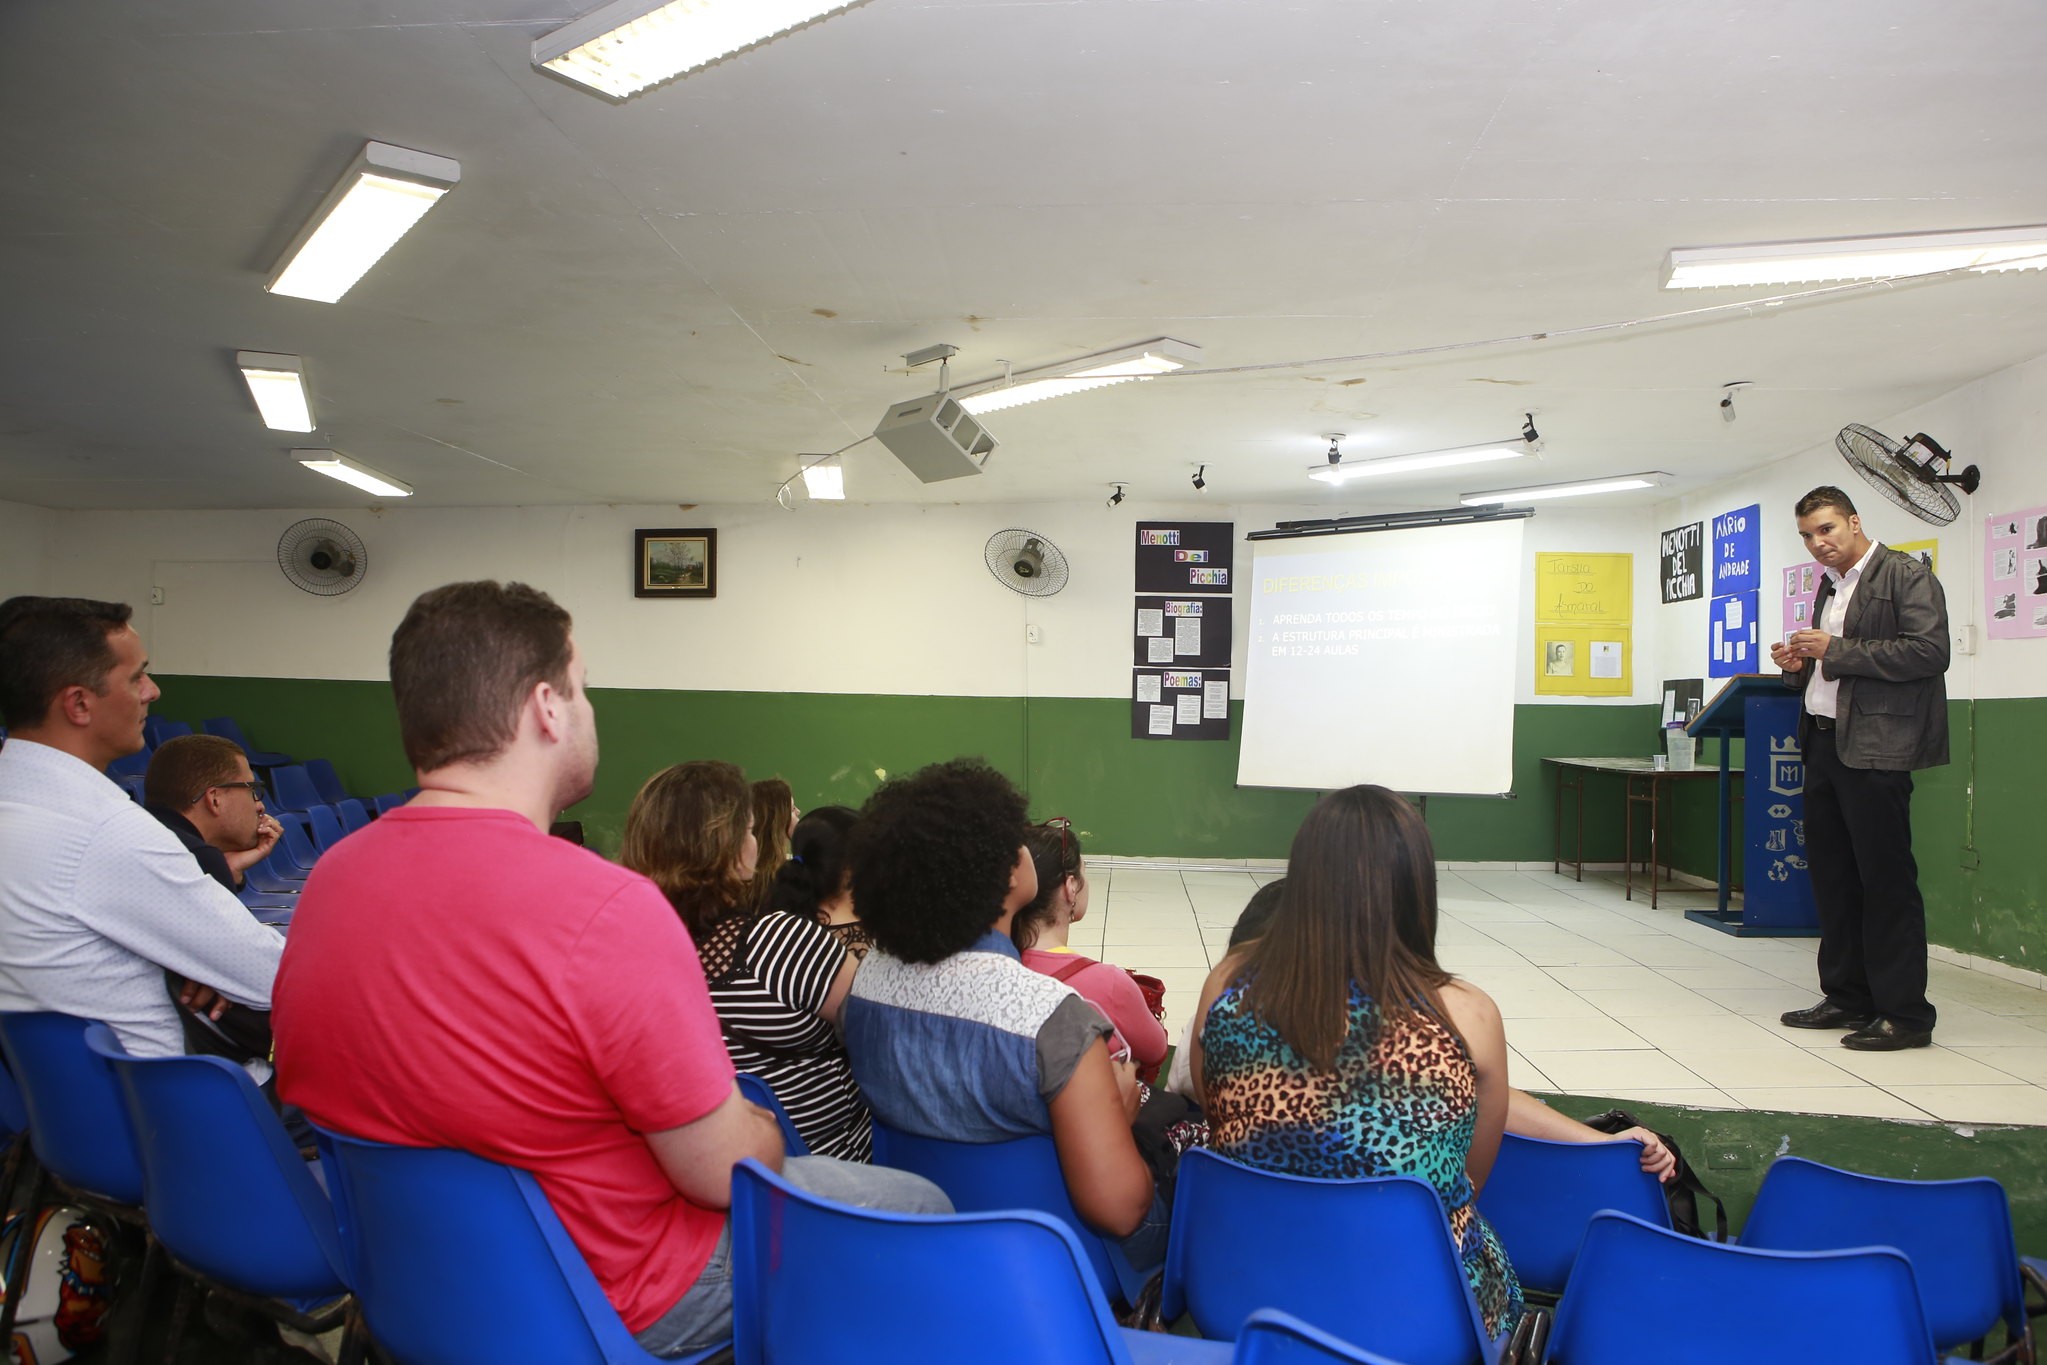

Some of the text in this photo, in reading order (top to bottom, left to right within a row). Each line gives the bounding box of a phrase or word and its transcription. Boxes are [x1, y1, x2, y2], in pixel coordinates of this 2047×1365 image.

[1141, 530, 1180, 545] Menotti
[1662, 522, 1700, 557] MENOTTI
[1175, 551, 1209, 562] Del
[1724, 543, 1735, 558] DE
[1672, 552, 1687, 576] DEL
[1719, 559, 1750, 580] ANDRADE
[1190, 569, 1228, 585] Picchia
[1263, 572, 1368, 595] DIFERENÇAS
[1666, 573, 1696, 601] PICCHIA
[1165, 602, 1203, 616] Biografia:
[1273, 612, 1322, 625] APRENDA
[1325, 610, 1364, 623] TODOS
[1367, 609, 1385, 622] OS
[1272, 631, 1280, 642] A
[1282, 629, 1345, 642] ESTRUTURA
[1348, 627, 1409, 640] PRINCIPAL
[1271, 644, 1360, 656] EM 12-24 AULAS
[1164, 672, 1202, 687] Poemas:
